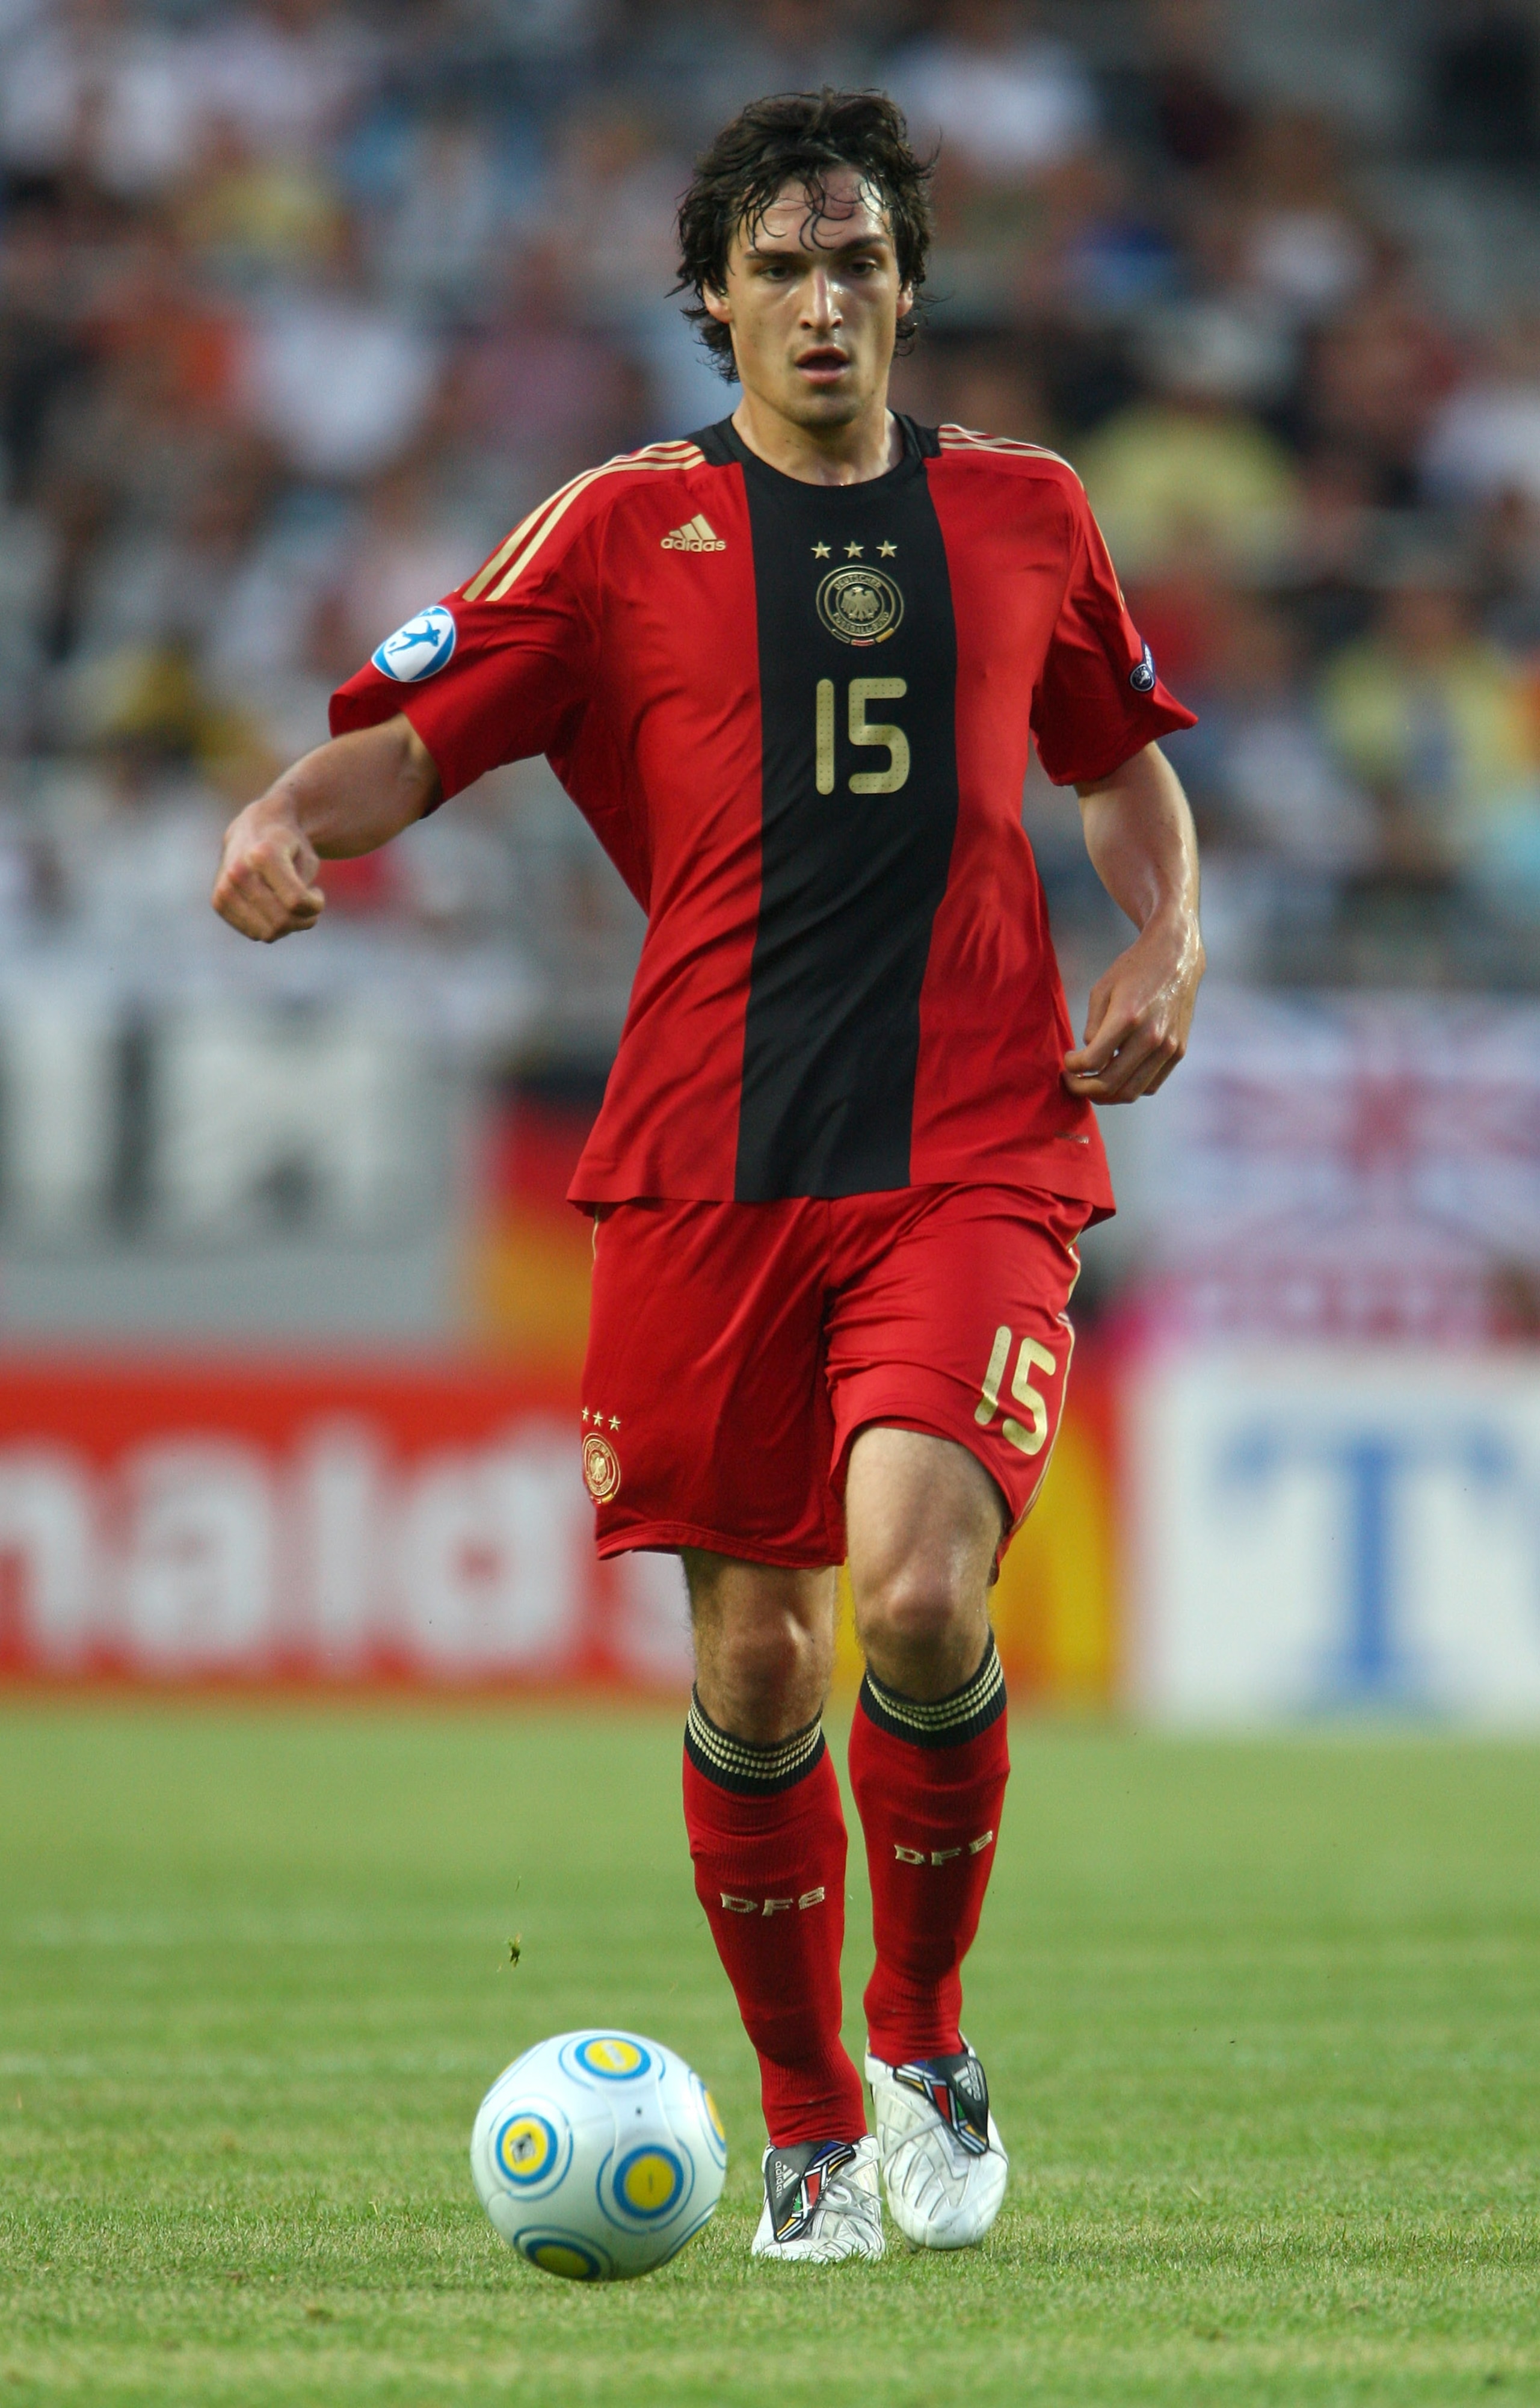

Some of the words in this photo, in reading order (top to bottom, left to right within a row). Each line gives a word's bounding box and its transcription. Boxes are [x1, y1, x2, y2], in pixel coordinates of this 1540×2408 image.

[660, 537, 727, 552] adidas
[833, 574, 882, 590] DEUTSCHER
[816, 677, 910, 795] 15
[973, 1325, 1056, 1456] 15
[893, 1830, 993, 1866] DFB
[719, 1886, 825, 1917] DFB
[775, 2160, 784, 2199] adidas
